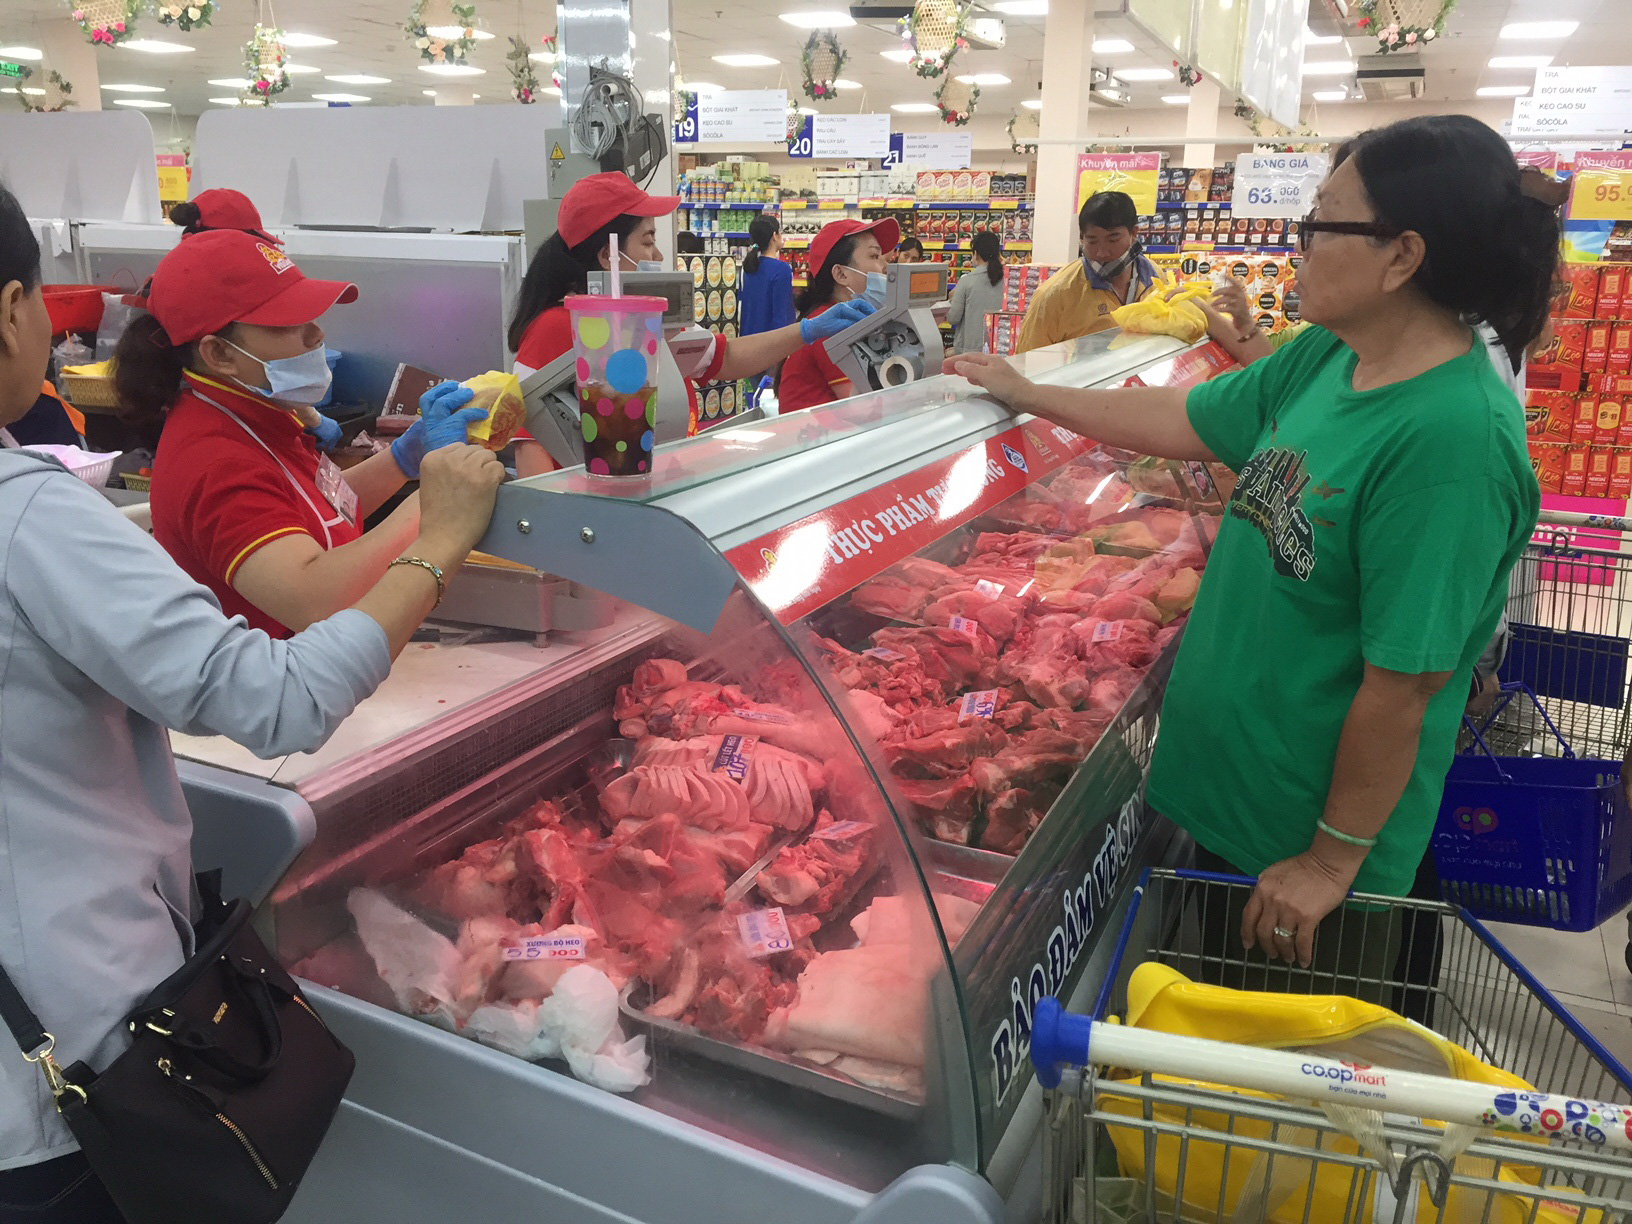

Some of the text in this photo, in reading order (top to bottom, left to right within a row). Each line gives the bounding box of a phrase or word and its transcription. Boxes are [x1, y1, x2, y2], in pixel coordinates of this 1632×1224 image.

[678, 117, 695, 138] 19
[789, 137, 811, 155] 20
[882, 149, 899, 167] 21
[875, 494, 936, 536] PHẨM
